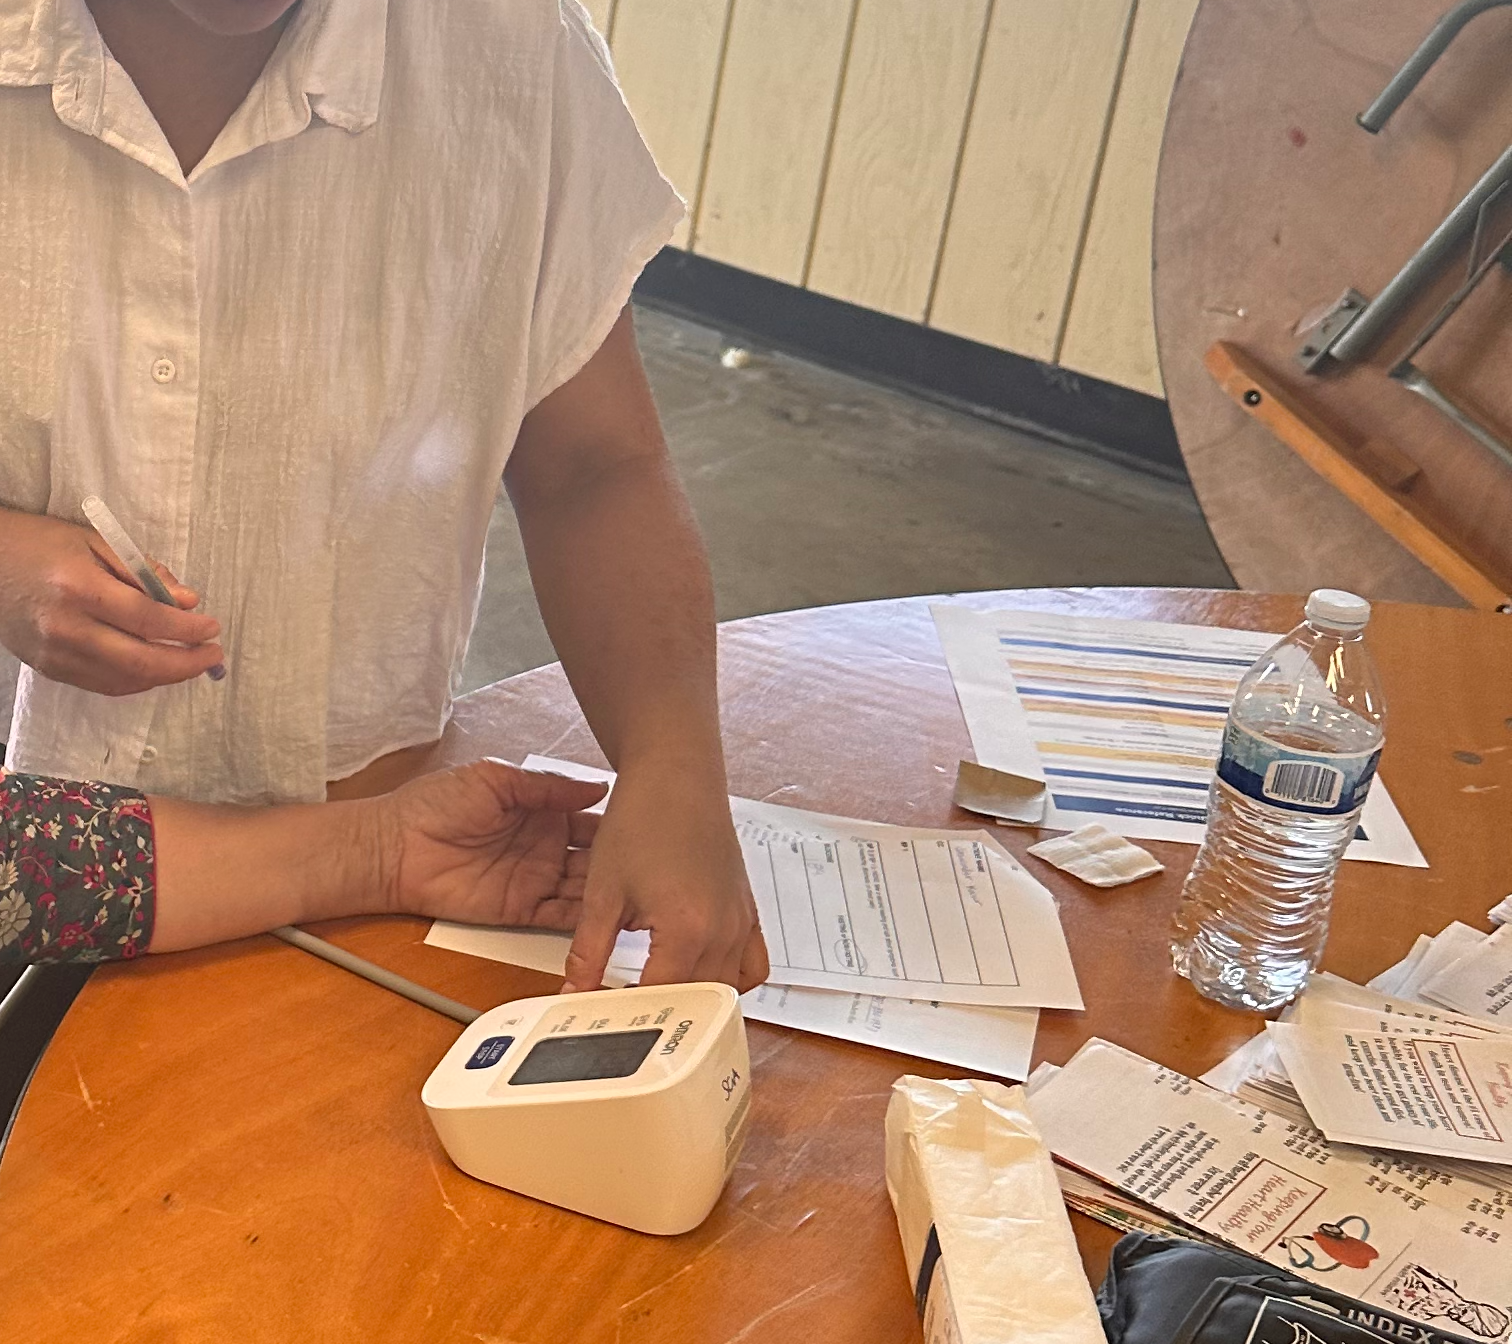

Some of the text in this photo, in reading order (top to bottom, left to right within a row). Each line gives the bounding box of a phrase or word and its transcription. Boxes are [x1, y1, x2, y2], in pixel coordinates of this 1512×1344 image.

[1252, 1173, 1287, 1202] Heart
[1217, 1197, 1262, 1234] Healthy
[1245, 1187, 1307, 1245] Keeping Your
